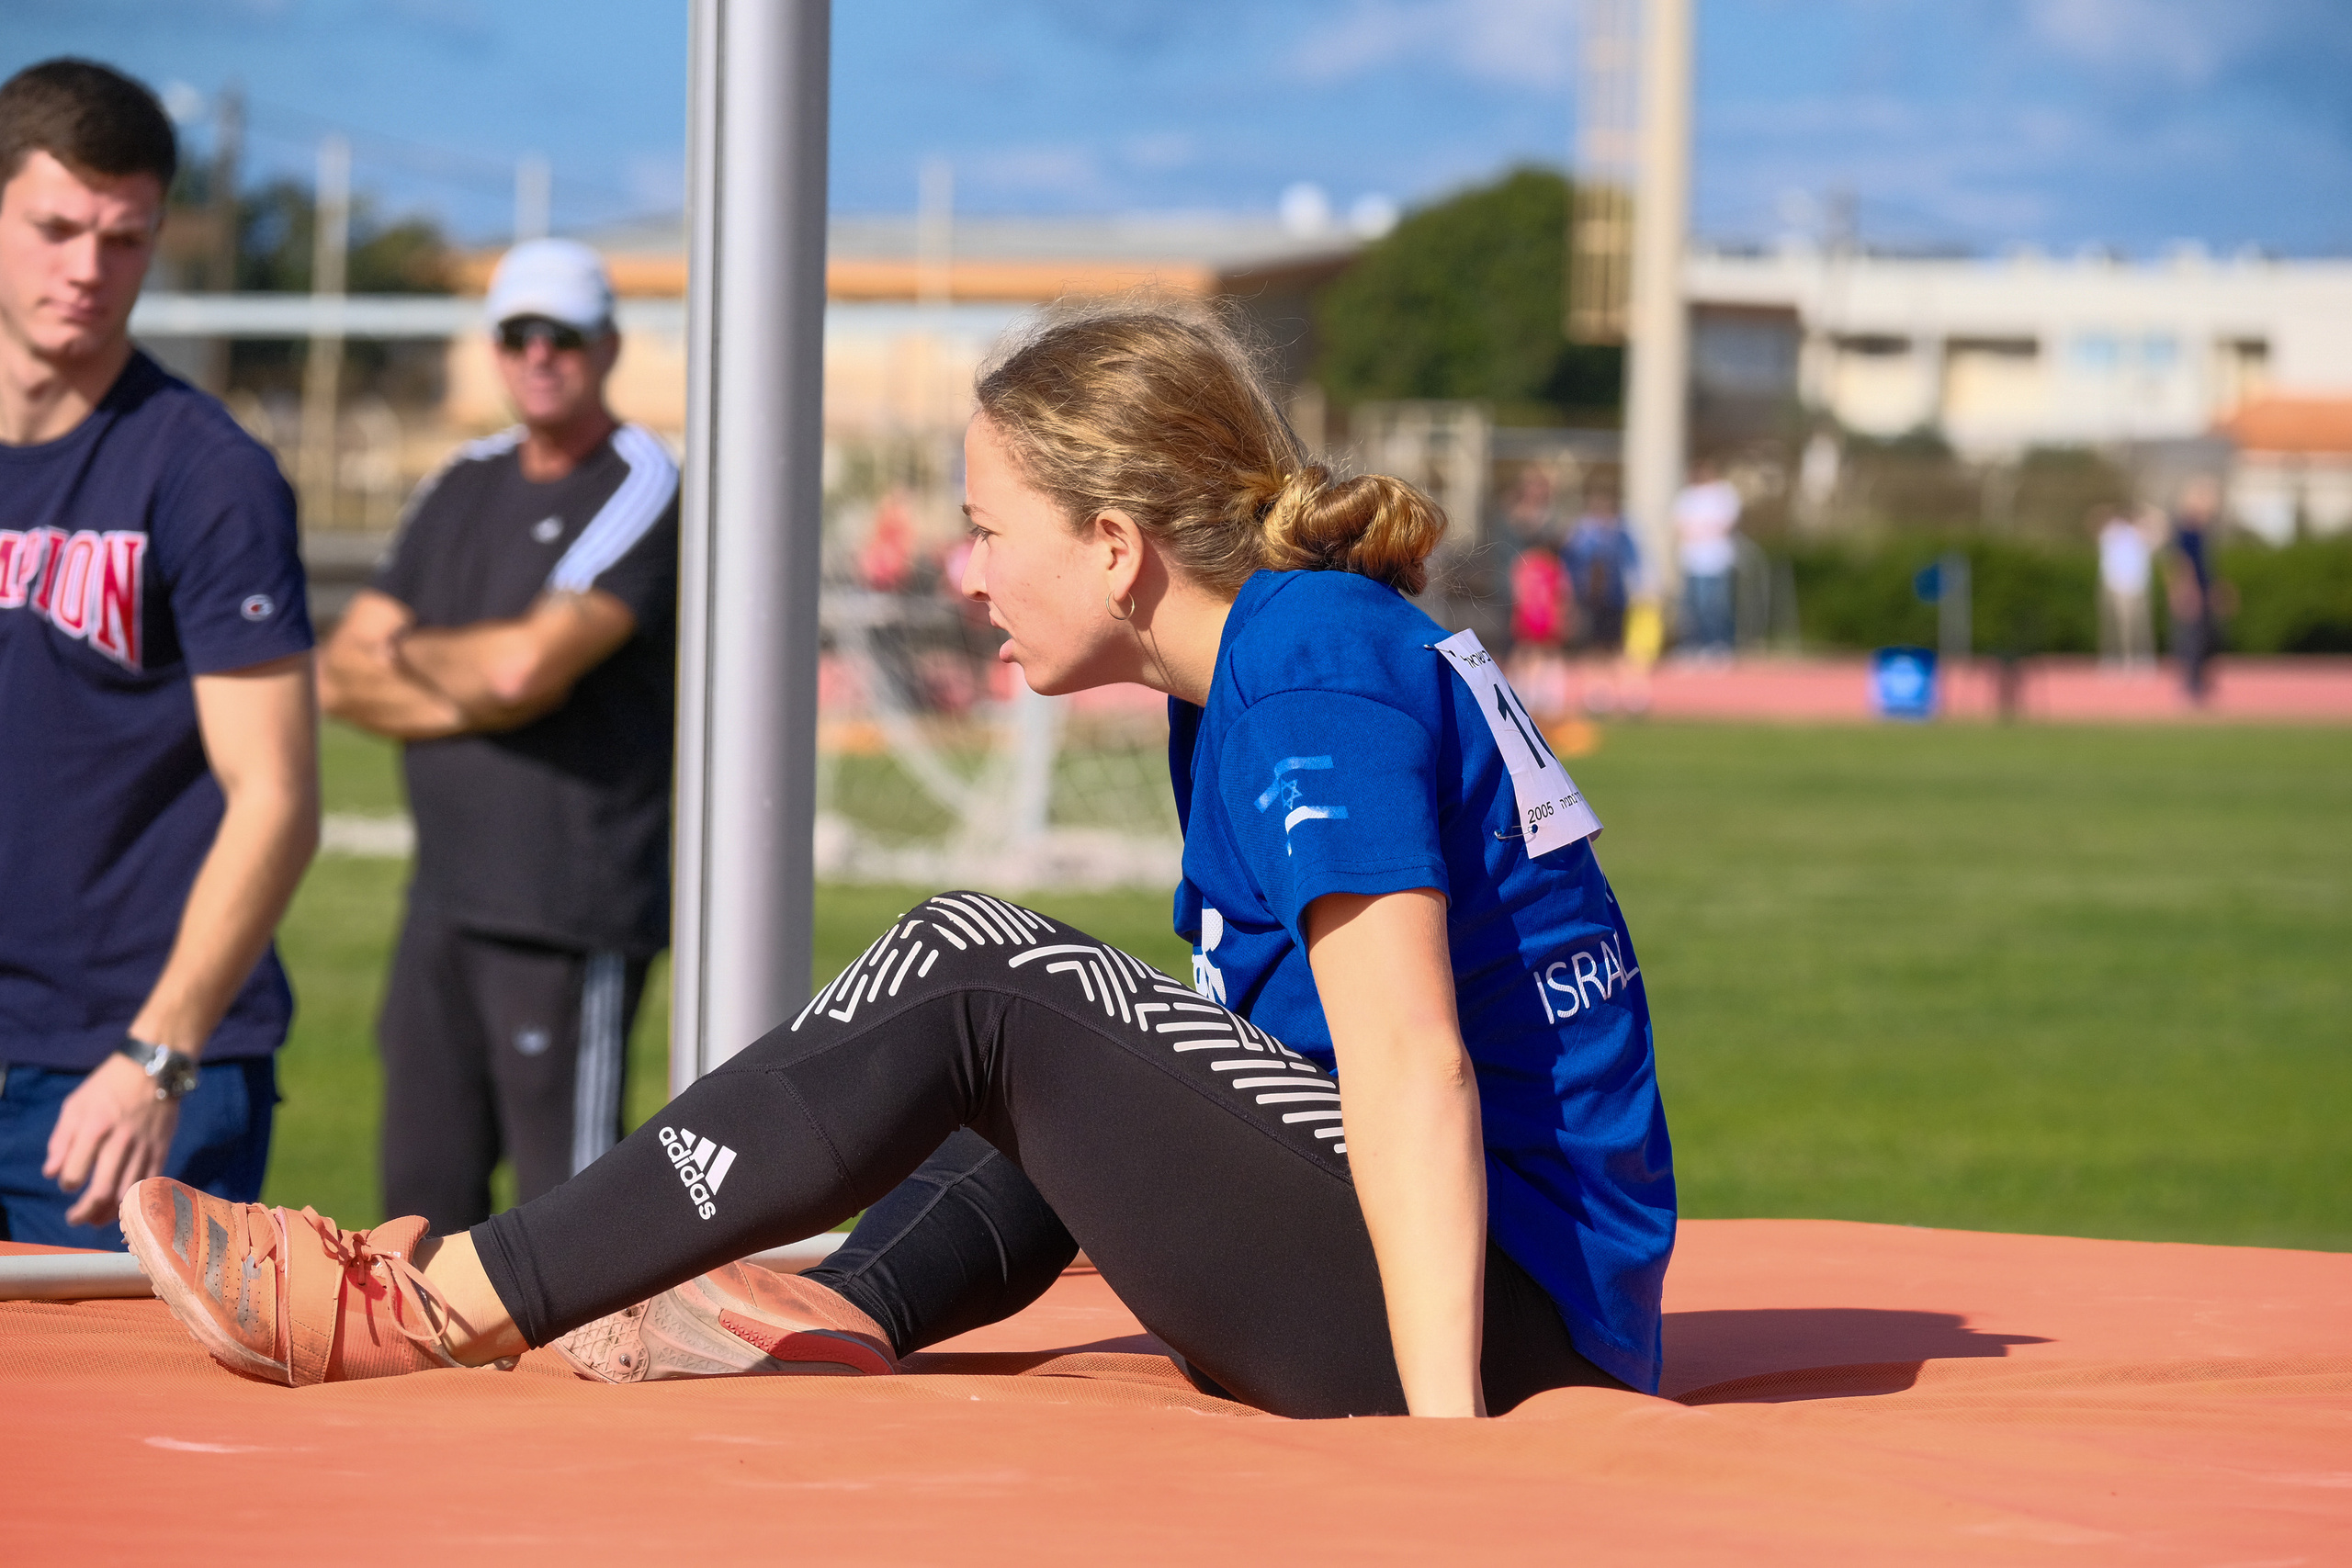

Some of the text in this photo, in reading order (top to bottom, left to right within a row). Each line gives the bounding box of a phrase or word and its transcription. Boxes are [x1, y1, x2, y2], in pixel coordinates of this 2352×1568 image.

[1493, 683, 1558, 769] 1
[1527, 801, 1555, 824] 2005
[659, 1126, 717, 1221] adidas
